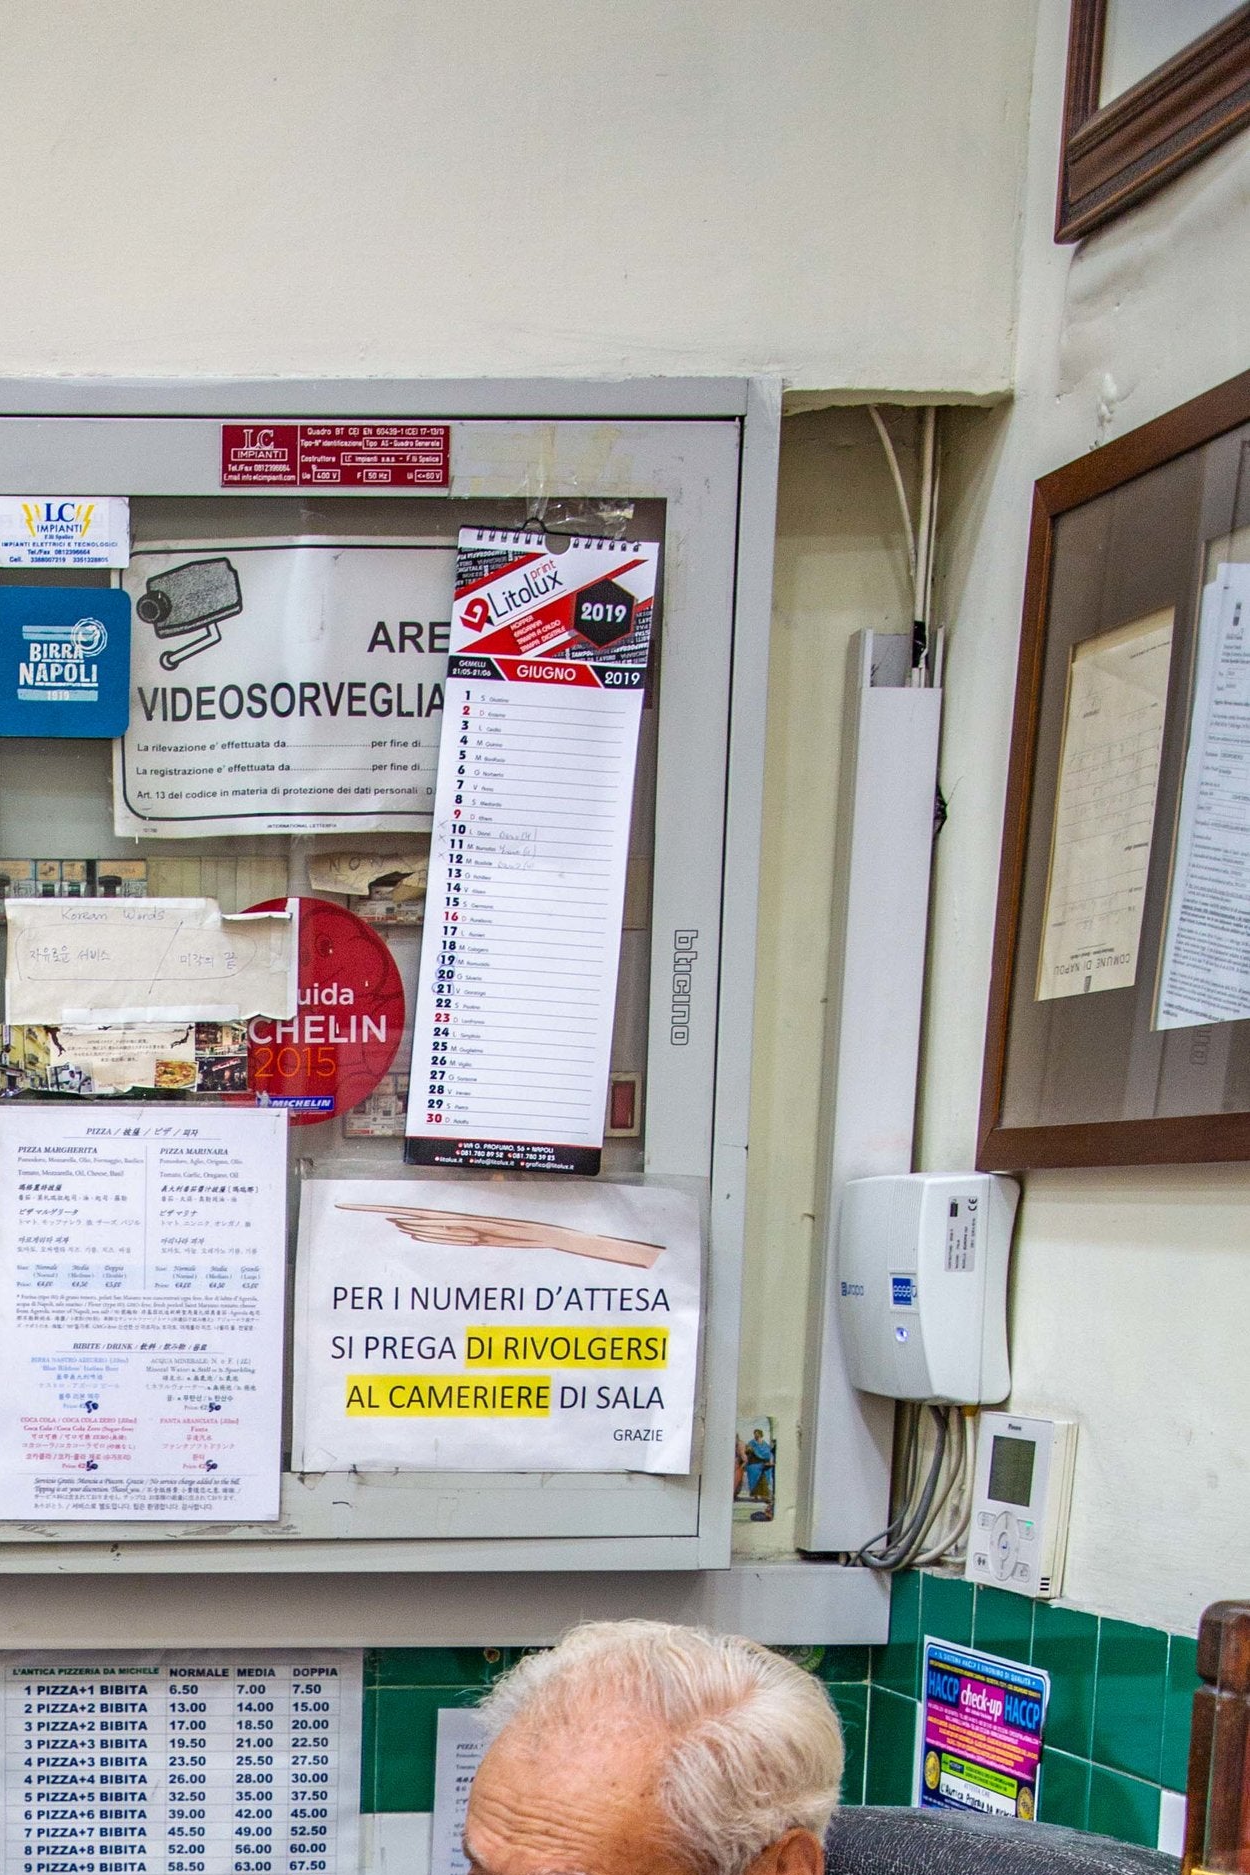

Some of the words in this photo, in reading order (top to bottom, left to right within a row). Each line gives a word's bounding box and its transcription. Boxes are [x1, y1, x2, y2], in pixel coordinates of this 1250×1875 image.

[243, 429, 274, 449] LC
[238, 451, 282, 459] IMPIANTI
[44, 502, 75, 523] LC
[37, 524, 82, 533] IMPIANTI
[529, 559, 556, 581] print
[487, 570, 564, 619] Litolux
[581, 602, 627, 623] 2019
[29, 642, 84, 662] BIRRA
[459, 660, 487, 668] GEMELLI
[19, 662, 98, 686] NAPOLI
[516, 665, 576, 681] GIUGNO
[604, 671, 640, 685] 2019
[464, 690, 471, 701] 1
[462, 705, 471, 716] 2
[461, 720, 469, 731] 3
[137, 744, 149, 752] La
[151, 743, 207, 753] rilevazione
[209, 742, 219, 750] e'
[221, 740, 270, 750] effettuata
[371, 740, 388, 749] per
[459, 735, 468, 745] 4
[458, 750, 466, 760] 5
[457, 765, 466, 776] 6
[137, 790, 152, 799] Art.
[156, 791, 166, 799] 13
[168, 790, 182, 799] del
[185, 790, 217, 799] codice
[220, 789, 229, 797] in
[232, 787, 268, 797] materia
[271, 786, 280, 795] di
[283, 786, 334, 797] protezione
[337, 785, 351, 794] dei
[354, 786, 371, 794] dati
[374, 787, 418, 797] personali
[451, 824, 466, 834] 10
[448, 854, 463, 864] 12
[61, 907, 108, 921] Korean
[671, 930, 699, 1046] bticino
[249, 1014, 387, 1044] CHELIN
[254, 1046, 336, 1078] 2015
[271, 1098, 332, 1110] MICHELIN
[86, 1128, 112, 1136] PIZZA
[18, 1146, 42, 1154] PIZZA
[333, 1286, 383, 1310] PER
[395, 1287, 400, 1310] I
[411, 1287, 524, 1311] NUMERI
[535, 1287, 671, 1312] D'ATTESA
[331, 1336, 352, 1360] SI
[365, 1336, 456, 1360] PREGA
[467, 1337, 493, 1360] DI
[504, 1337, 667, 1361] RIVOLGERSI
[346, 1385, 379, 1408] AL
[389, 1385, 550, 1409] CAMERIERE
[560, 1386, 586, 1409] DI
[596, 1386, 665, 1410] SALA
[613, 1429, 663, 1442] GRAZIE
[13, 1668, 56, 1676] L'ANTICA
[58, 1668, 100, 1676] PIZZERIA
[103, 1668, 116, 1676] DA
[118, 1667, 160, 1675] MICHELE
[169, 1668, 230, 1678] NORMALE
[237, 1668, 276, 1678] MEDIA
[293, 1667, 338, 1678] DOPPIA
[24, 1685, 32, 1696] 1
[37, 1685, 95, 1696] PIZZA+1
[100, 1684, 148, 1695] BIBITA
[169, 1684, 199, 1695] 6.50
[236, 1684, 266, 1695] 7.00
[291, 1683, 322, 1694] 7.50
[928, 1671, 959, 1704] HACCP
[24, 1703, 32, 1714] 2
[37, 1703, 95, 1714] PIZZA+2
[100, 1702, 148, 1713] BIBITA
[169, 1702, 206, 1713] 13.00
[236, 1702, 274, 1713] 14.00
[291, 1701, 329, 1712] 15.00
[961, 1683, 1002, 1723] check-up
[1004, 1694, 1040, 1730] HACCP
[24, 1721, 32, 1732] 3
[37, 1721, 95, 1732] PIZZA+2
[100, 1720, 148, 1731] BIBITA
[169, 1720, 206, 1731] 17.00
[236, 1720, 274, 1731] 18.50
[291, 1719, 329, 1730] 20.00
[24, 1739, 32, 1750] 3
[37, 1739, 95, 1750] PIZZA+3
[100, 1738, 148, 1749] BIBITA
[169, 1738, 206, 1749] 19.50
[236, 1738, 274, 1749] 21.00
[291, 1737, 329, 1748] 22.50
